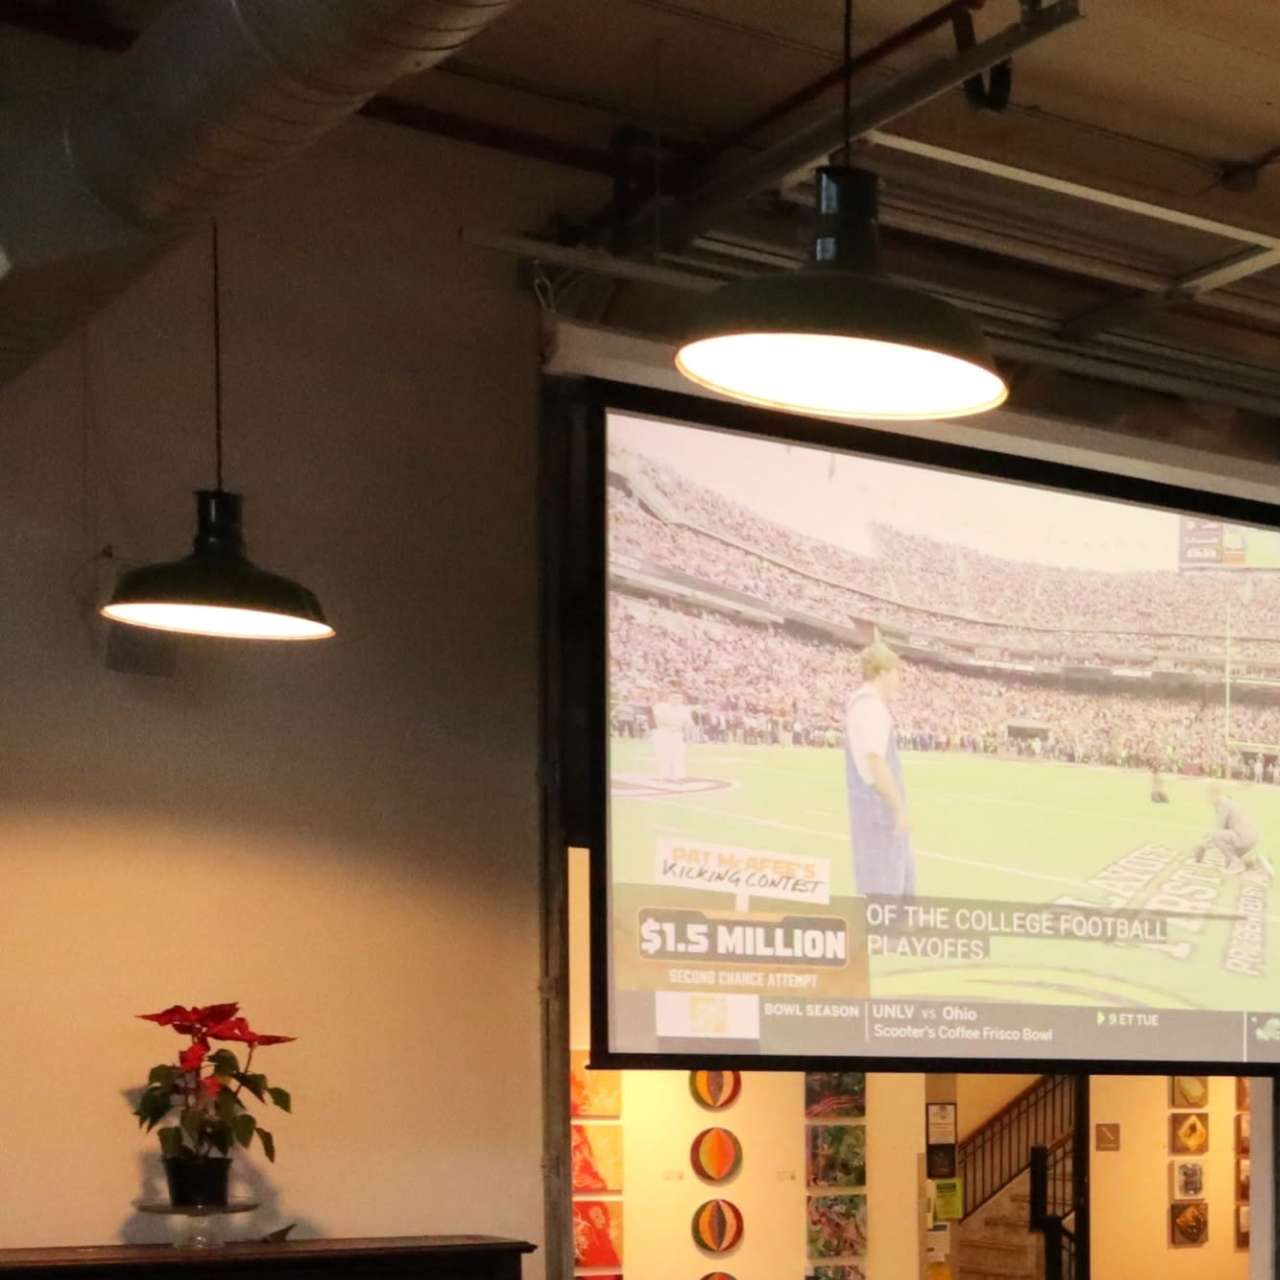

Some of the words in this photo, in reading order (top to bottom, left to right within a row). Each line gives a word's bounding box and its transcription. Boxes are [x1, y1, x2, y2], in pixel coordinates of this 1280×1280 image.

[662, 859, 741, 887] KICKING
[745, 873, 824, 894] CONTEST
[866, 903, 898, 926] OF
[904, 906, 949, 929] THE
[955, 909, 1053, 935] COLLEGE
[1060, 915, 1167, 940] FOOTBALL
[641, 917, 709, 955] $1.5
[717, 925, 846, 959] MILLION
[718, 971, 764, 987] CHANCE
[768, 973, 817, 988] ATTEMPT
[764, 1003, 802, 1016] BOWL
[806, 1004, 859, 1017] SEASON
[873, 1004, 914, 1018] UNLV
[942, 1006, 977, 1021] Ohio
[1108, 1013, 1117, 1025] 9
[1119, 1014, 1134, 1025] ET
[1136, 1014, 1160, 1026] TUE
[873, 1024, 936, 1039] Scooter's
[938, 1026, 980, 1040] Coffee
[983, 1027, 1019, 1040] Frisco
[1022, 1028, 1053, 1041] Bowl
